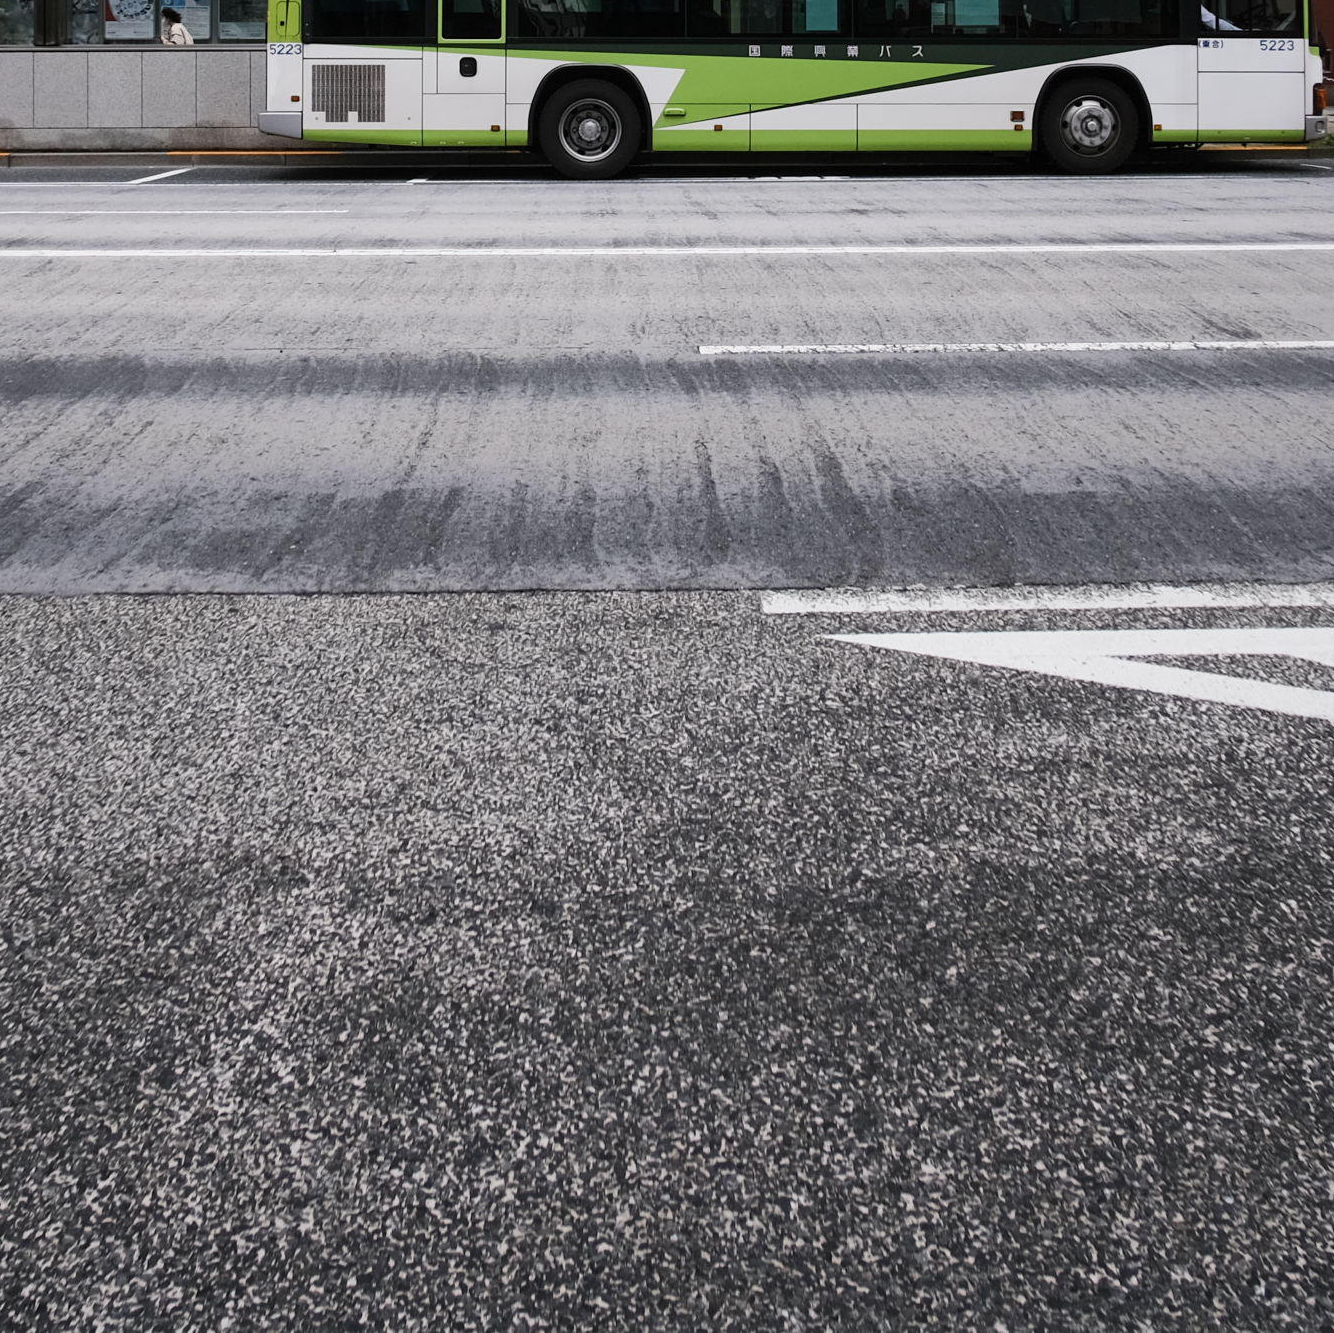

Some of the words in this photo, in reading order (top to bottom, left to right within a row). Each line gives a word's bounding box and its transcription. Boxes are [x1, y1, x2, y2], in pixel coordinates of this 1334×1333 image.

[269, 44, 302, 55] 5223
[748, 45, 924, 57] 国際興業バス
[1260, 40, 1295, 51] 5223
